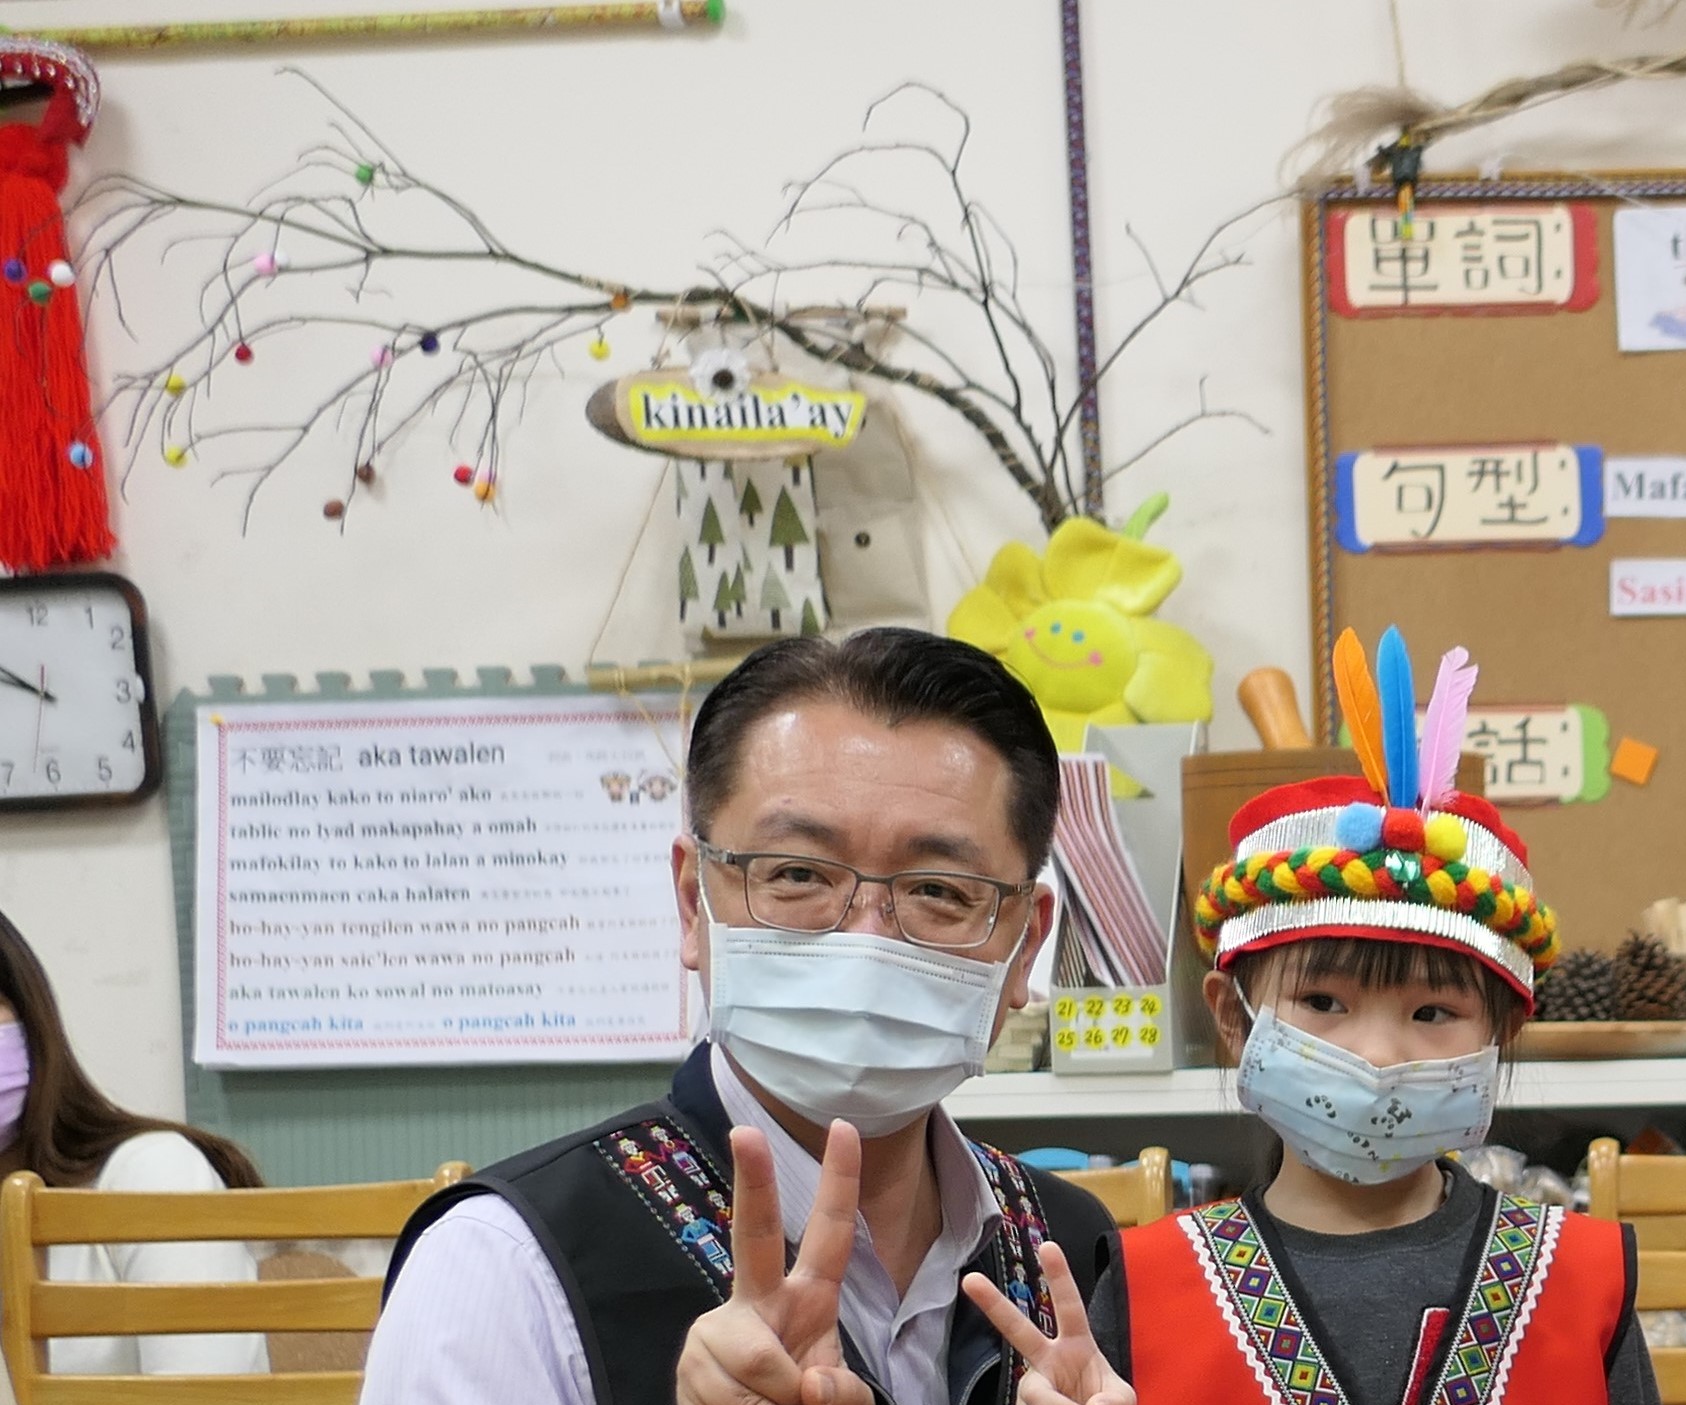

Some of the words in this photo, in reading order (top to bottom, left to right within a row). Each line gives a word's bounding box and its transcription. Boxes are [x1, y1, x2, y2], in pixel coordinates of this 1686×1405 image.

[26, 605, 48, 627] 12
[85, 606, 94, 629] 1
[111, 626, 124, 650] 2
[117, 680, 131, 703] 3
[122, 731, 135, 753] 4
[359, 743, 401, 768] aka
[408, 739, 505, 767] tawalen
[1, 761, 15, 786] 7
[46, 759, 61, 784] 6
[98, 757, 112, 782] 5
[327, 788, 371, 806] kako
[377, 790, 394, 805] to
[354, 853, 397, 871] kako
[1057, 1000, 1073, 1017] 21
[1086, 999, 1103, 1016] 22
[1113, 997, 1131, 1014] 23
[1140, 998, 1157, 1014] 24
[1057, 1031, 1075, 1047] 25
[1085, 1028, 1103, 1044] 26
[1111, 1026, 1129, 1045] 27
[1140, 1026, 1158, 1044] 28
